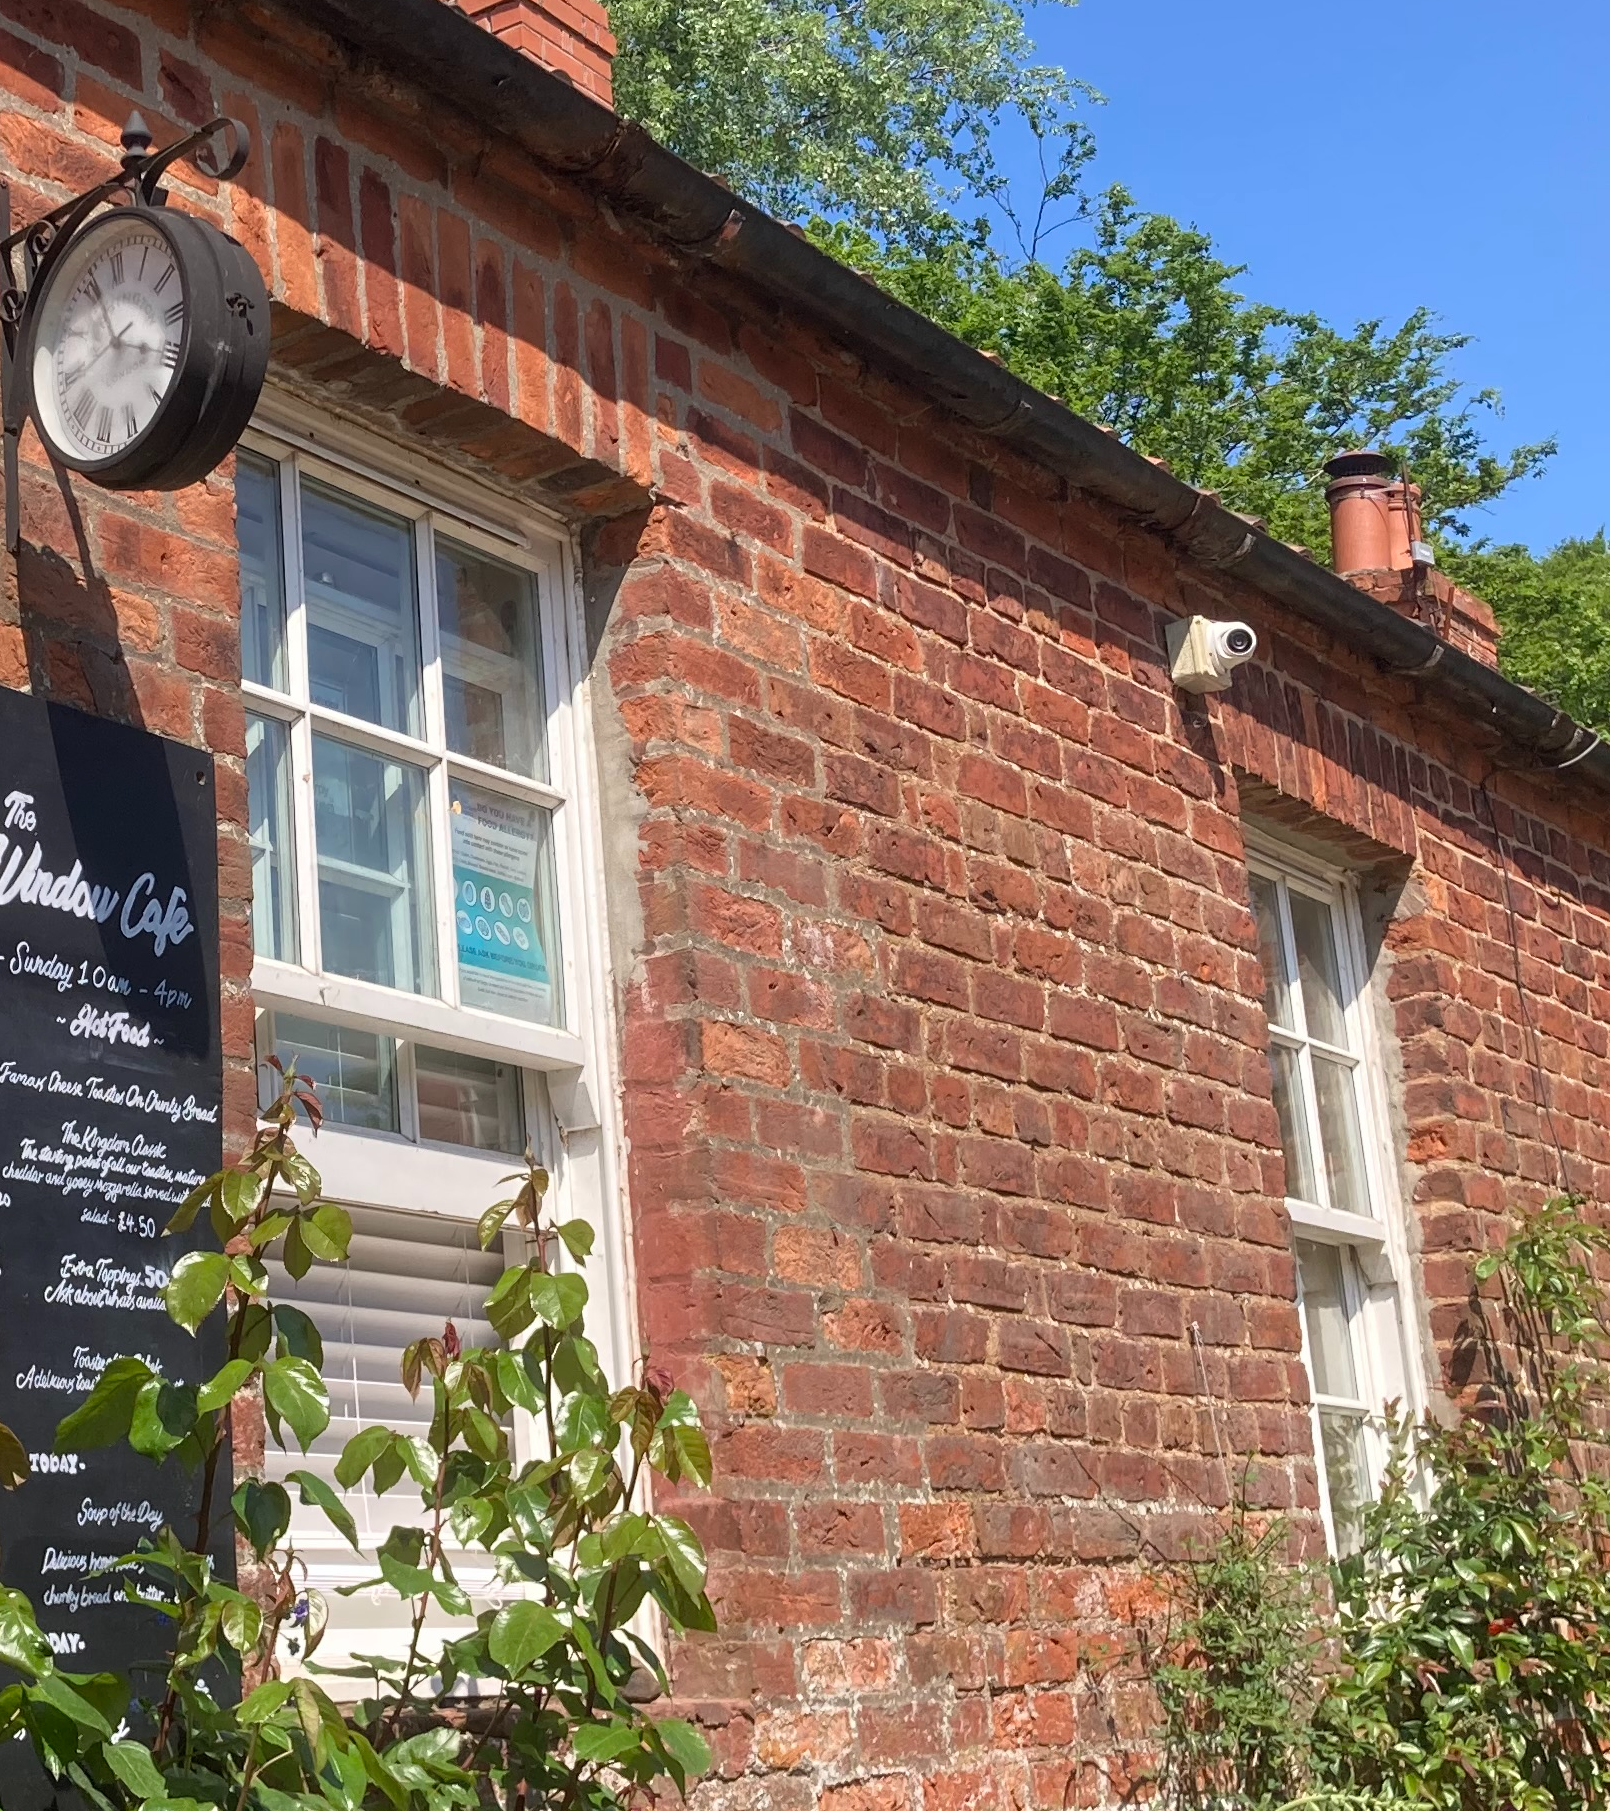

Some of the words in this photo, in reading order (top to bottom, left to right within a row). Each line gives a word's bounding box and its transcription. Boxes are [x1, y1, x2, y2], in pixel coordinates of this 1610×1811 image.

[3, 789, 37, 831] The
[9, 941, 74, 992] Sunday
[153, 978, 193, 1010] 4pm
[106, 1011, 151, 1048] Food
[144, 1089, 182, 1123] Chunky
[181, 1094, 219, 1124] Bread
[19, 1136, 39, 1161] The
[61, 1119, 81, 1146] The
[79, 1124, 131, 1158] Kingdom
[1, 1160, 44, 1184] cheddar
[44, 1168, 66, 1186] and
[117, 1210, 156, 1239] £4.50
[59, 1253, 95, 1279] Extra
[28, 1452, 78, 1475] TODAY
[77, 1496, 110, 1527] Soup
[109, 1501, 121, 1527] of
[120, 1503, 137, 1523] the
[136, 1500, 165, 1532] Day
[40, 1546, 88, 1575] Delicious
[43, 1583, 80, 1614] chunky
[79, 1583, 112, 1608] bread
